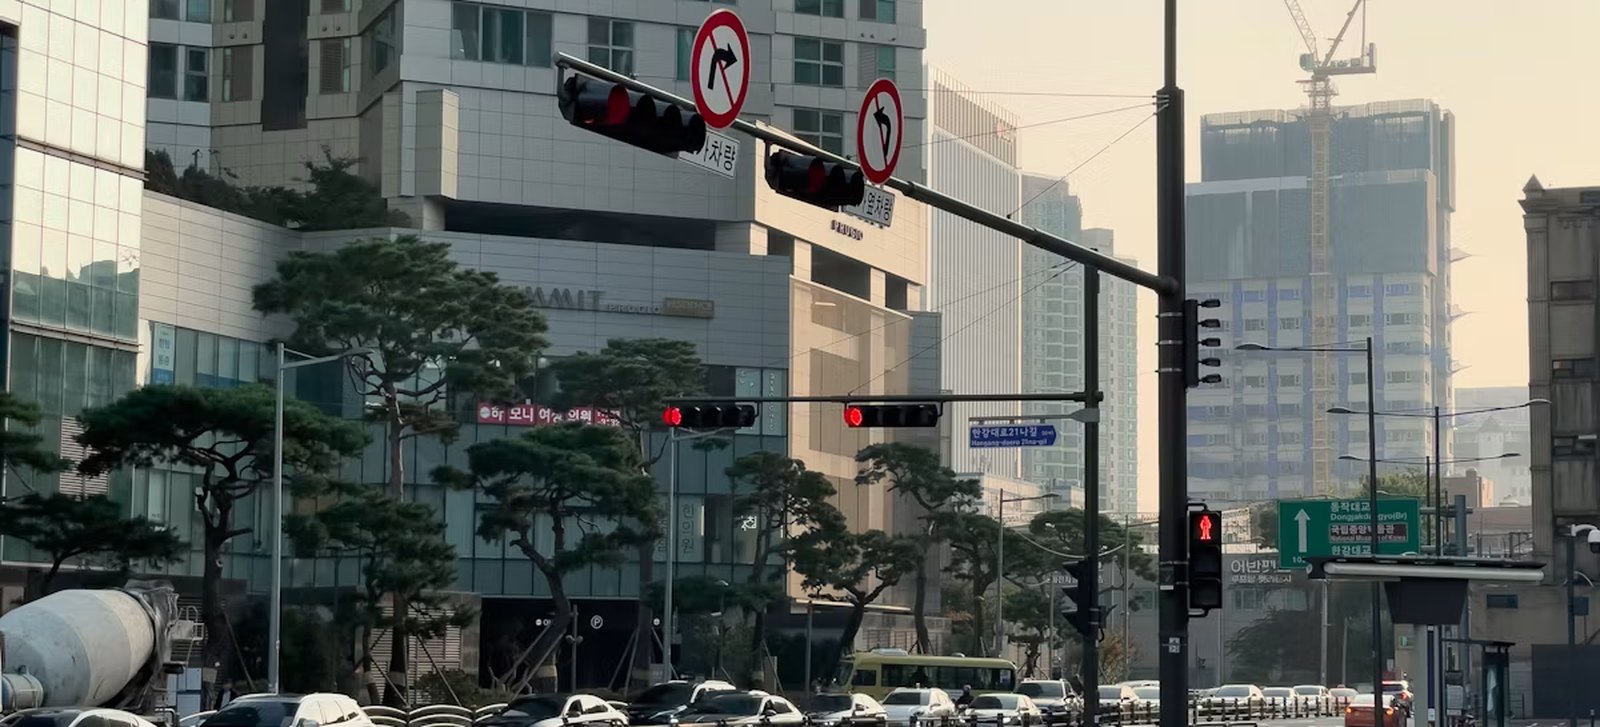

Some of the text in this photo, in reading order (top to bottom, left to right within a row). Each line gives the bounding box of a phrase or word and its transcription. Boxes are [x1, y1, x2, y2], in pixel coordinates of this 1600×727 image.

[525, 286, 606, 312] MMIT
[1330, 501, 1371, 512] 동작대교
[1330, 512, 1408, 521] Dongjakdgyo(Br)
